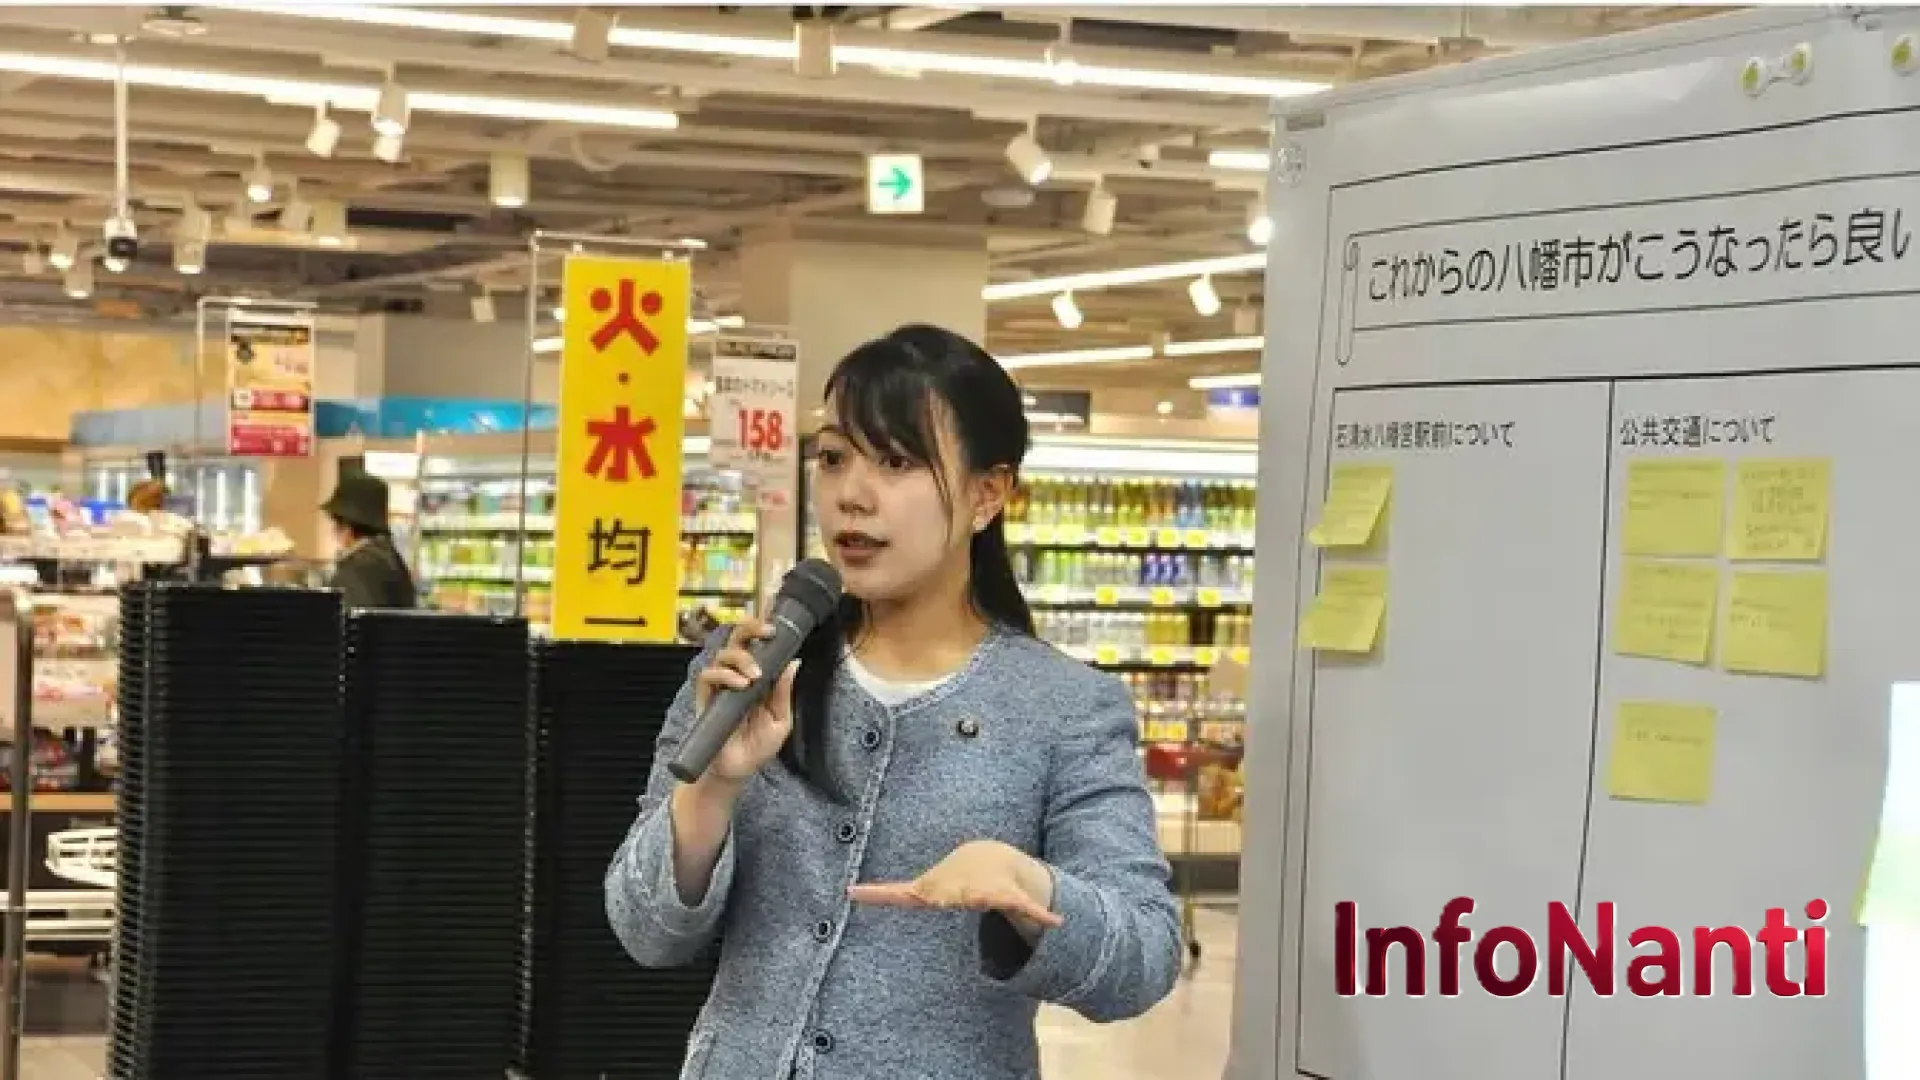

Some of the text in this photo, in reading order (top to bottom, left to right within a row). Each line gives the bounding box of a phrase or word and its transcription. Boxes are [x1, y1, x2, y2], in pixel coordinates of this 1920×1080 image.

[738, 408, 783, 451] 158
[1620, 415, 1775, 447] 公共交通について
